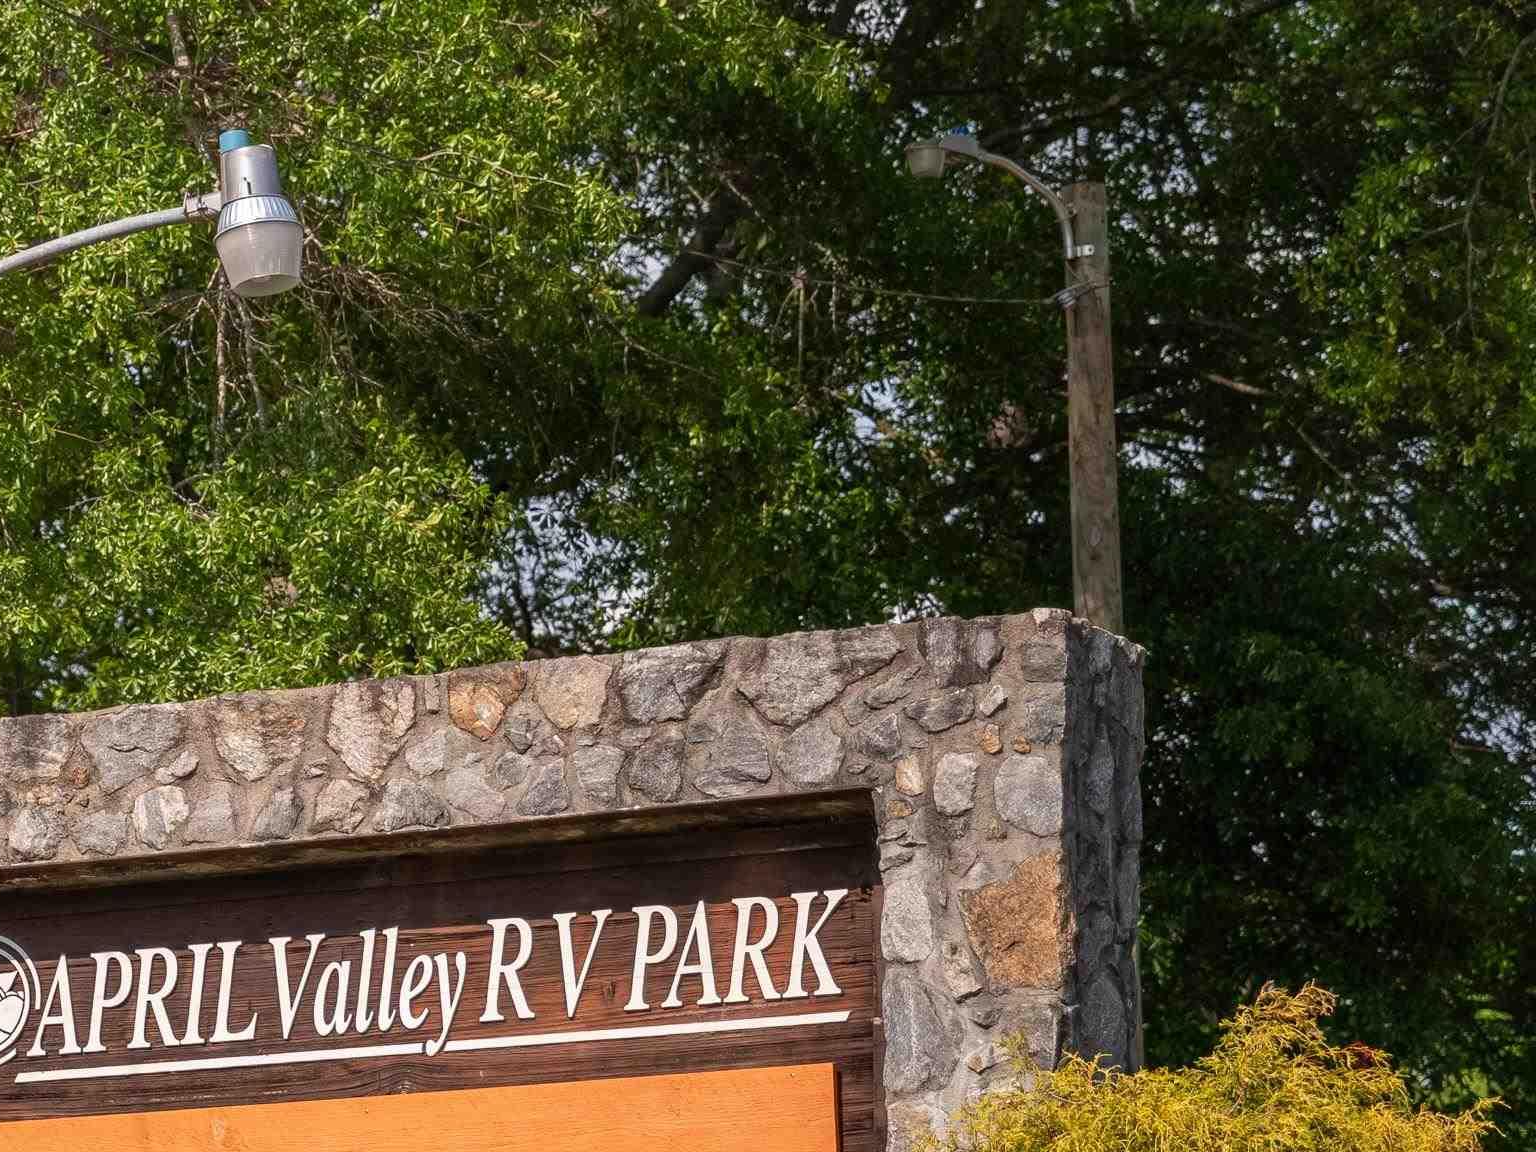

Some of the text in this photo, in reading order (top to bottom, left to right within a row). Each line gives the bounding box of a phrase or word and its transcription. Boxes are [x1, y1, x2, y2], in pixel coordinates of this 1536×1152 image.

[26, 889, 848, 1057] APRIL Valley R V PARK
